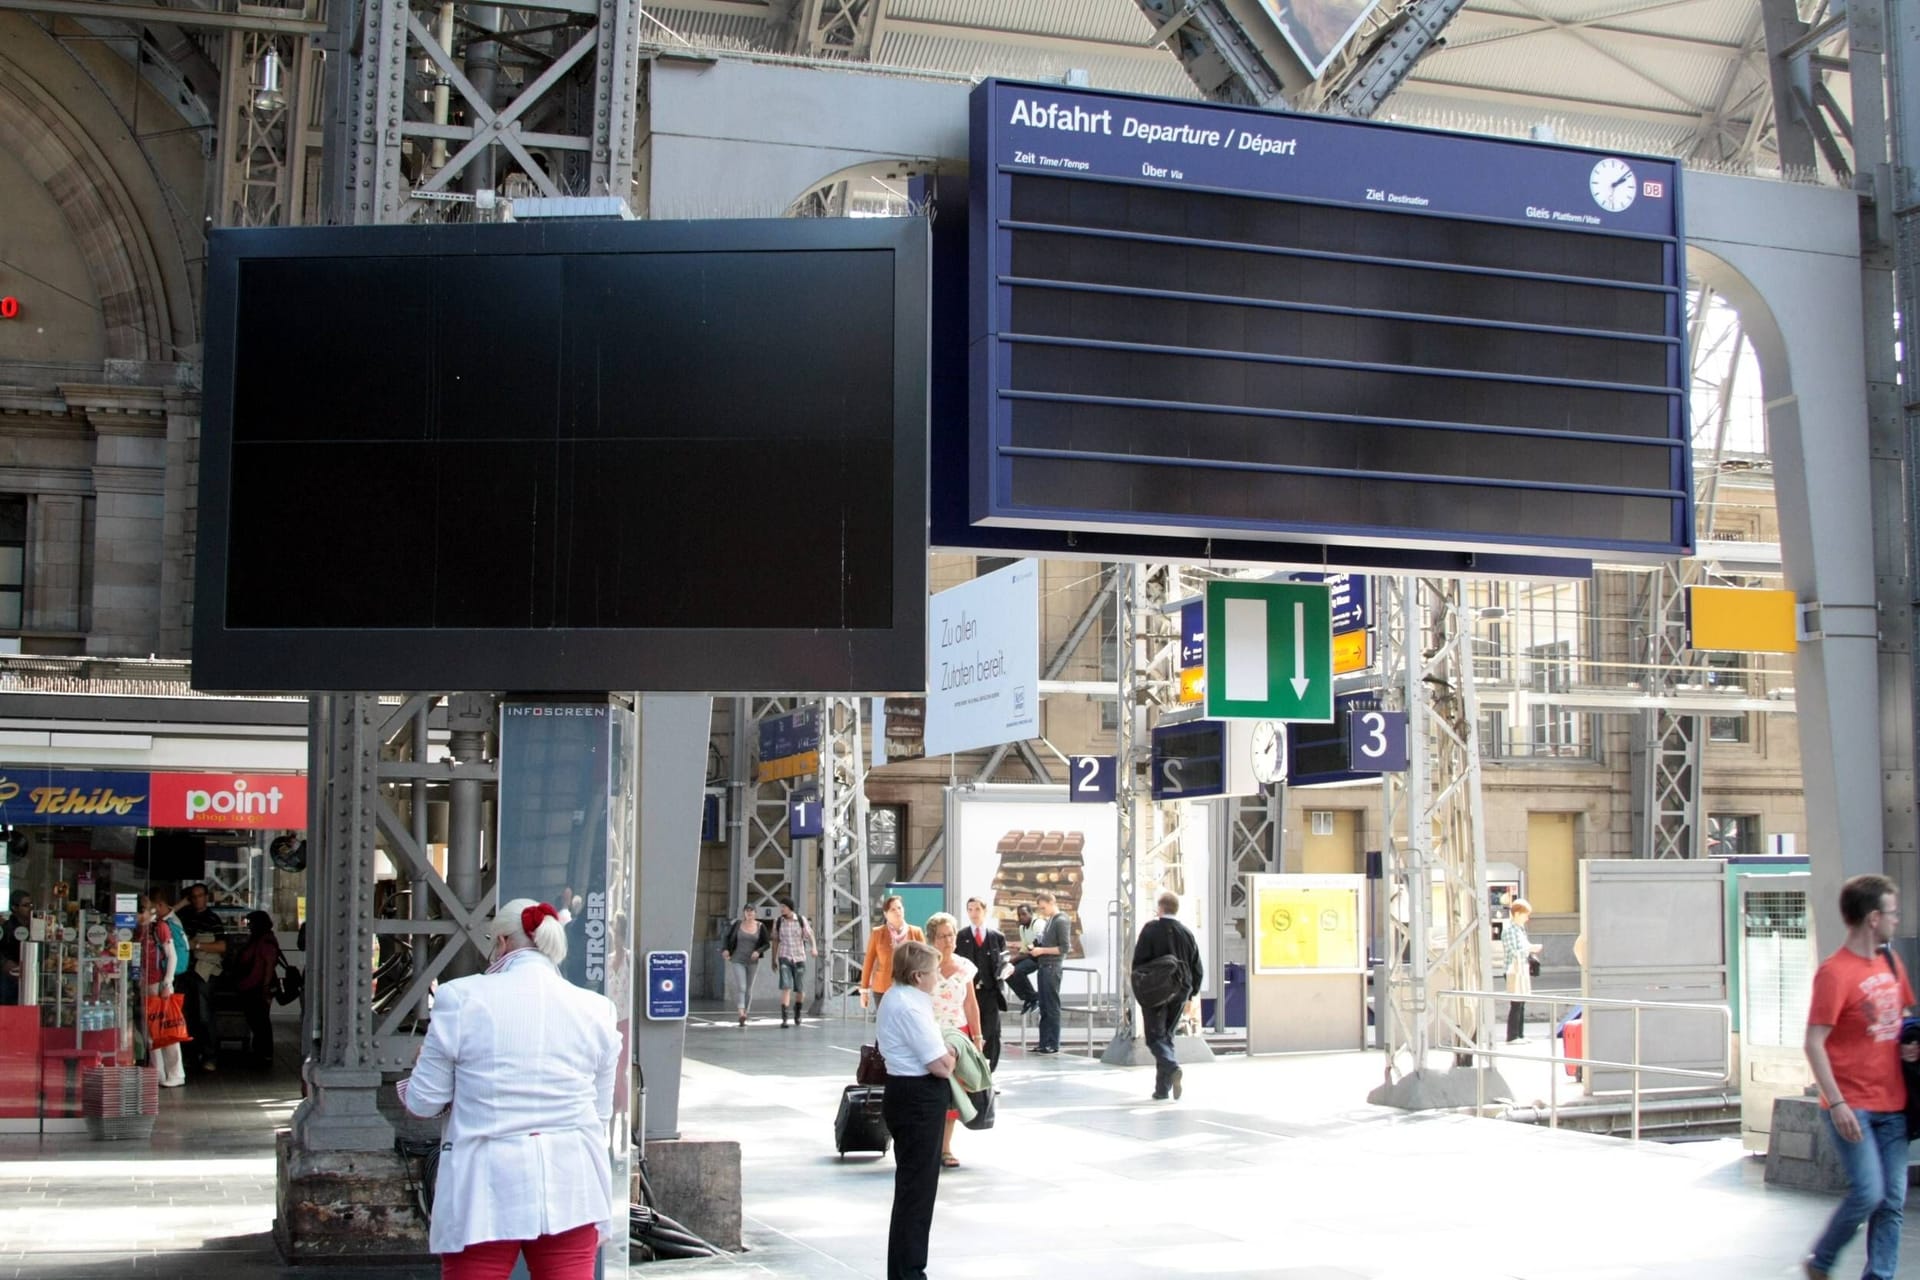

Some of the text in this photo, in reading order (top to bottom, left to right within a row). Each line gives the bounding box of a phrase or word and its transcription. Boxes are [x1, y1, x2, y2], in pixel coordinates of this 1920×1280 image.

[1010, 99, 1297, 156] Abfahrt Departure / Départ
[1014, 150, 1036, 165] Zeit
[1142, 162, 1184, 180] Über Via
[1365, 188, 1429, 206] Ziel Destination
[1644, 183, 1661, 197] DB
[1526, 206, 1550, 220] Gleis
[941, 610, 977, 649] Zu allen
[941, 649, 1007, 692] Zutaten bereit.
[507, 707, 605, 717] INFOSCREEN
[1360, 711, 1387, 758] 3
[1078, 757, 1100, 792] 2
[30, 787, 147, 815] Tchibo
[185, 778, 284, 821] point
[195, 813, 227, 822] shop
[794, 802, 806, 828] 1
[584, 891, 606, 982] STRÖER
